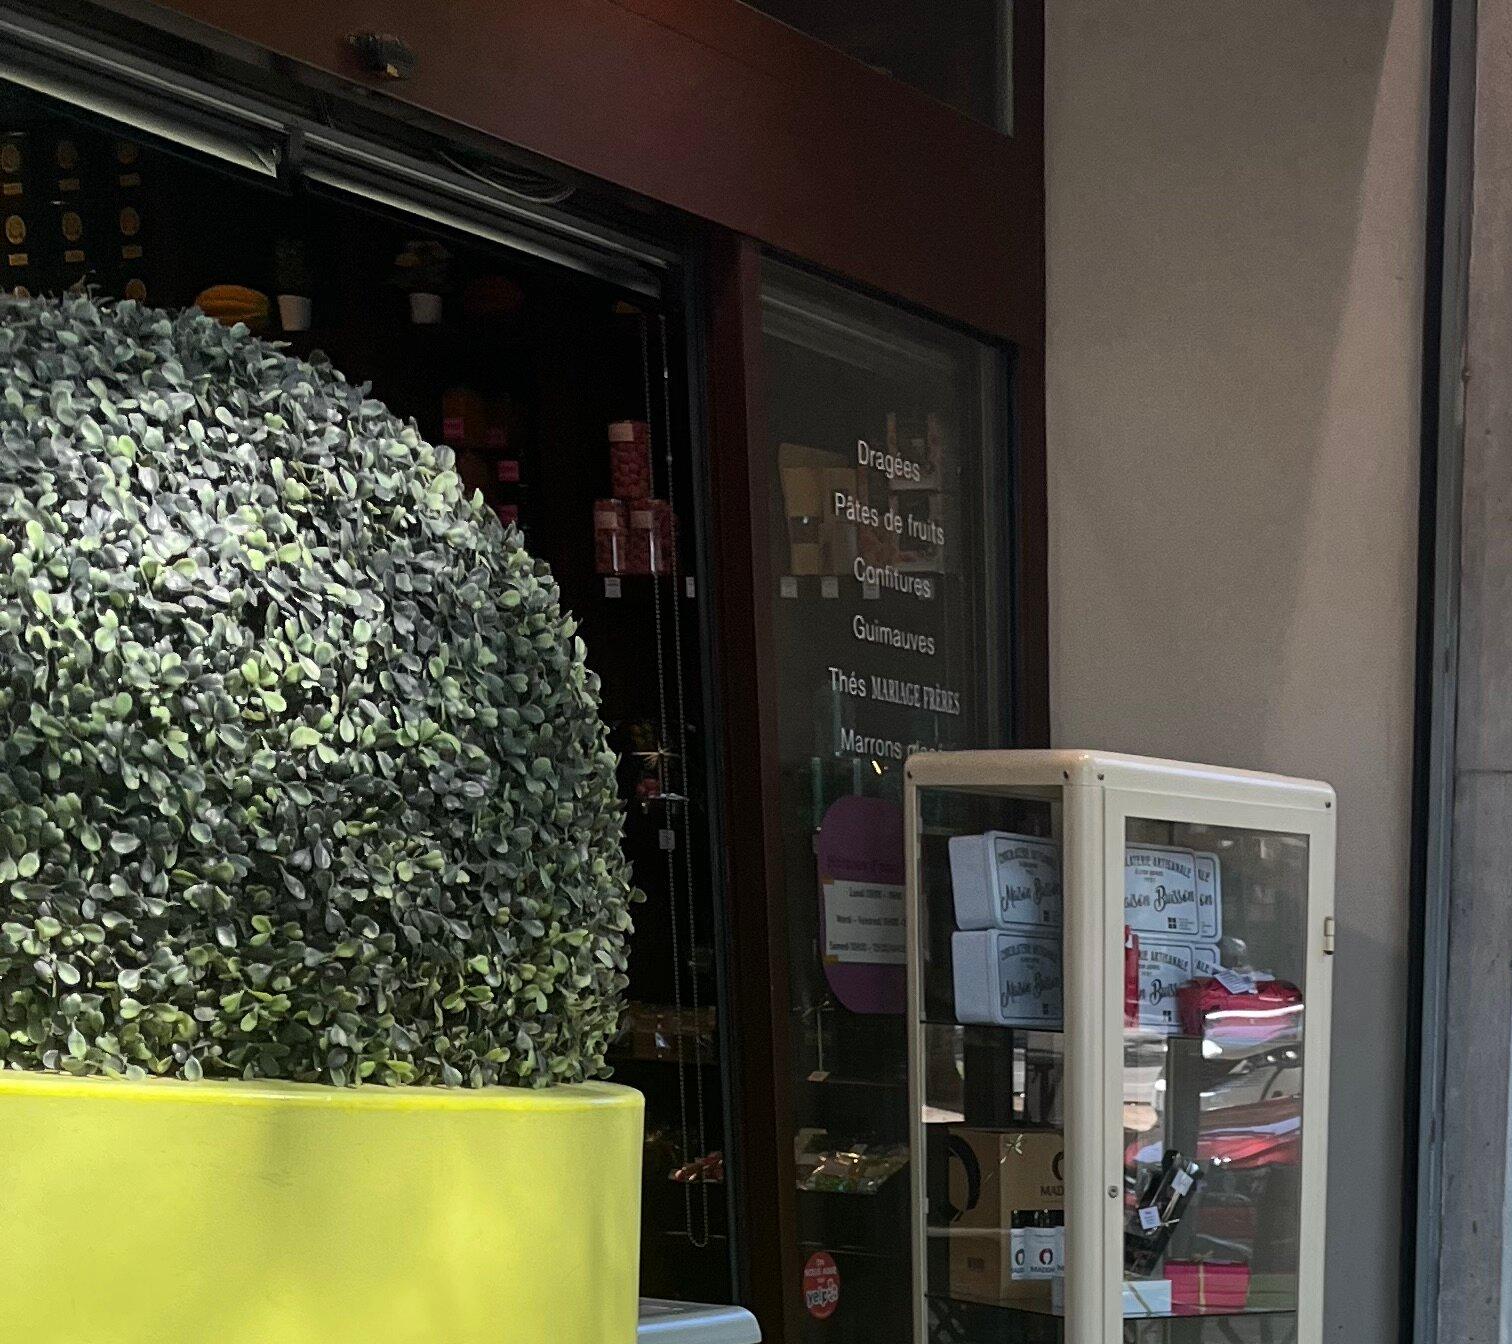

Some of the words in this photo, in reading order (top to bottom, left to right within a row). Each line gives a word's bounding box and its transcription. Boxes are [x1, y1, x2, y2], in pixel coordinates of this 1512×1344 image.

[857, 439, 921, 482] Dragées
[834, 491, 880, 528] Pâtes
[884, 508, 904, 534] de
[908, 513, 945, 546] fruits
[854, 556, 934, 599] Confitures
[853, 614, 936, 656] Guimauves
[828, 667, 867, 698] Thés
[871, 675, 921, 708] MARIAGE
[841, 727, 903, 760] Marrons
